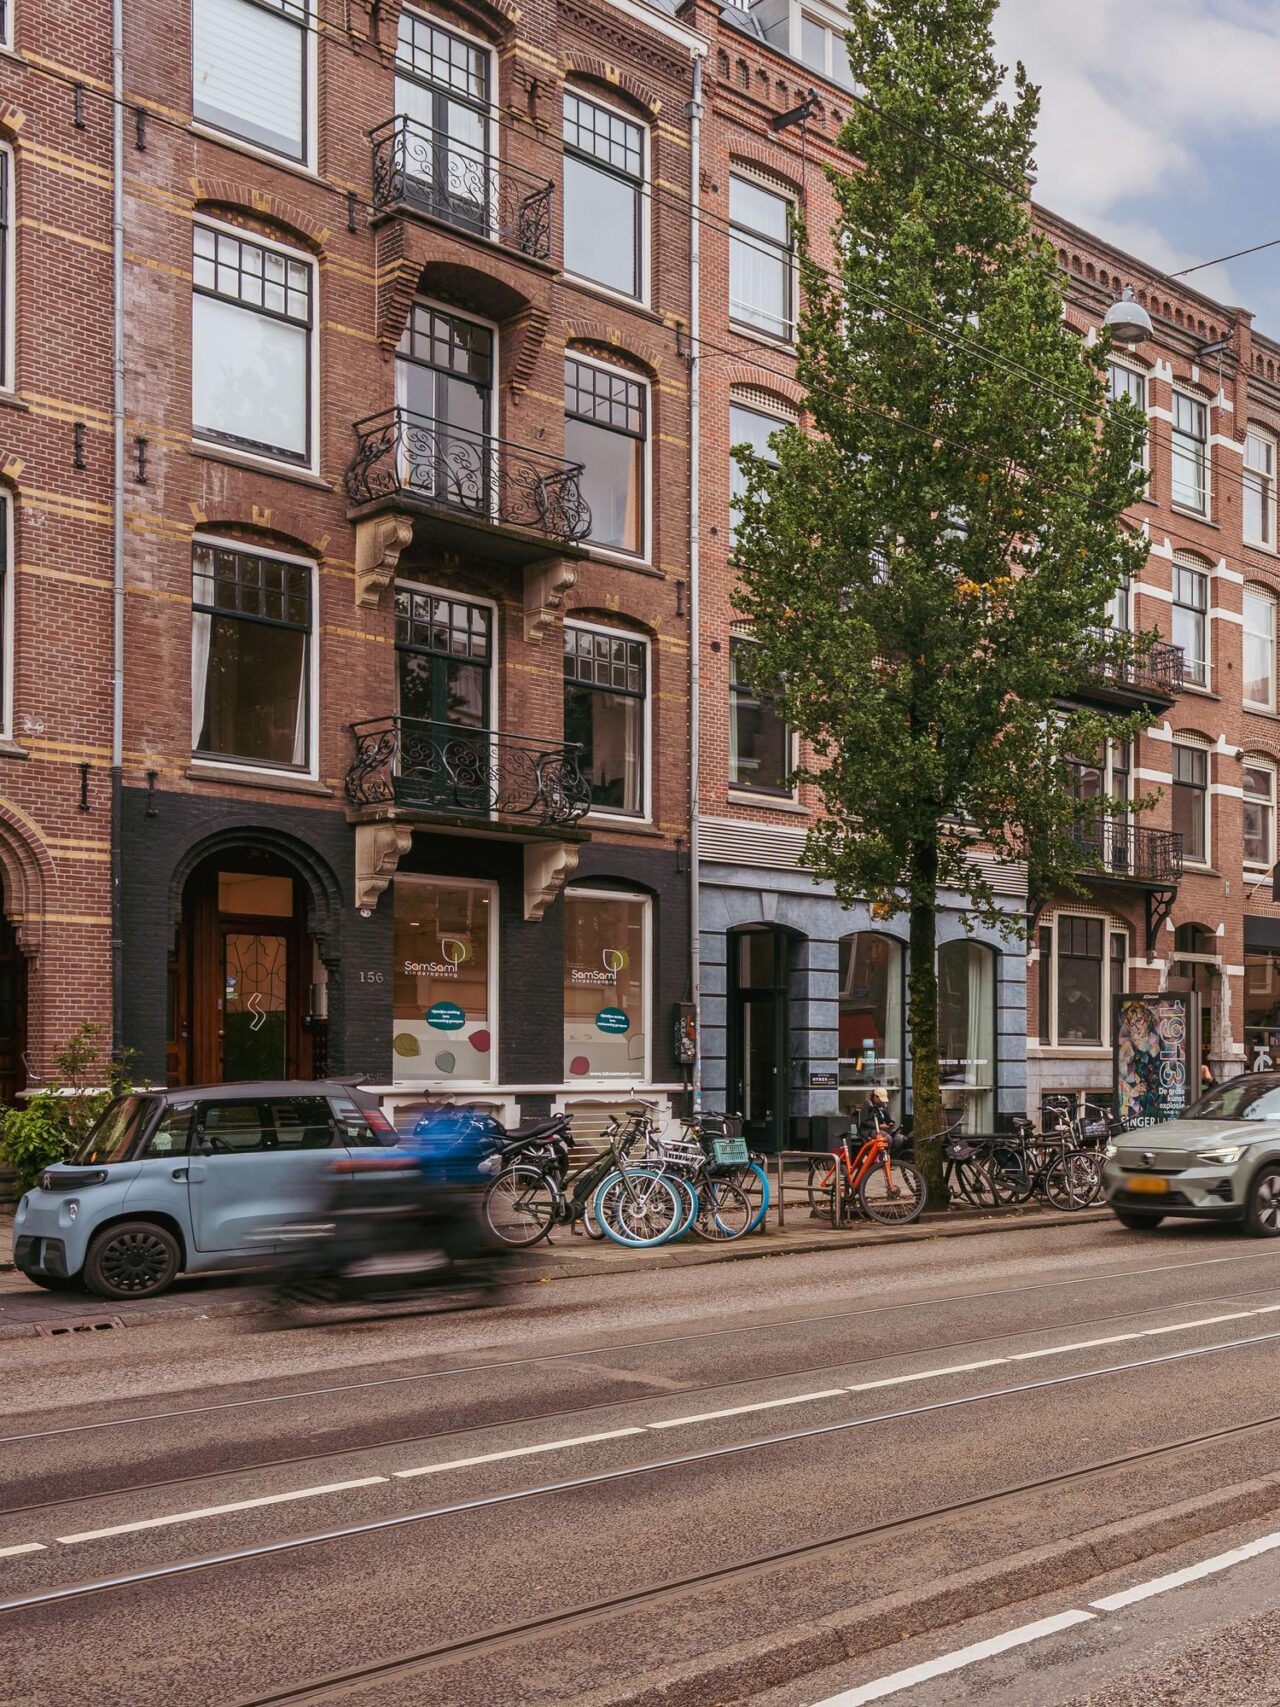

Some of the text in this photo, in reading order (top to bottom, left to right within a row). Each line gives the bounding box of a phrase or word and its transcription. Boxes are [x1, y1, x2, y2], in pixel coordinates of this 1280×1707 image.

[360, 971, 384, 983] 156
[1159, 1000, 1186, 1088] 1913
[1158, 1087, 1168, 1095] De
[1120, 1116, 1156, 1128] SINGER
